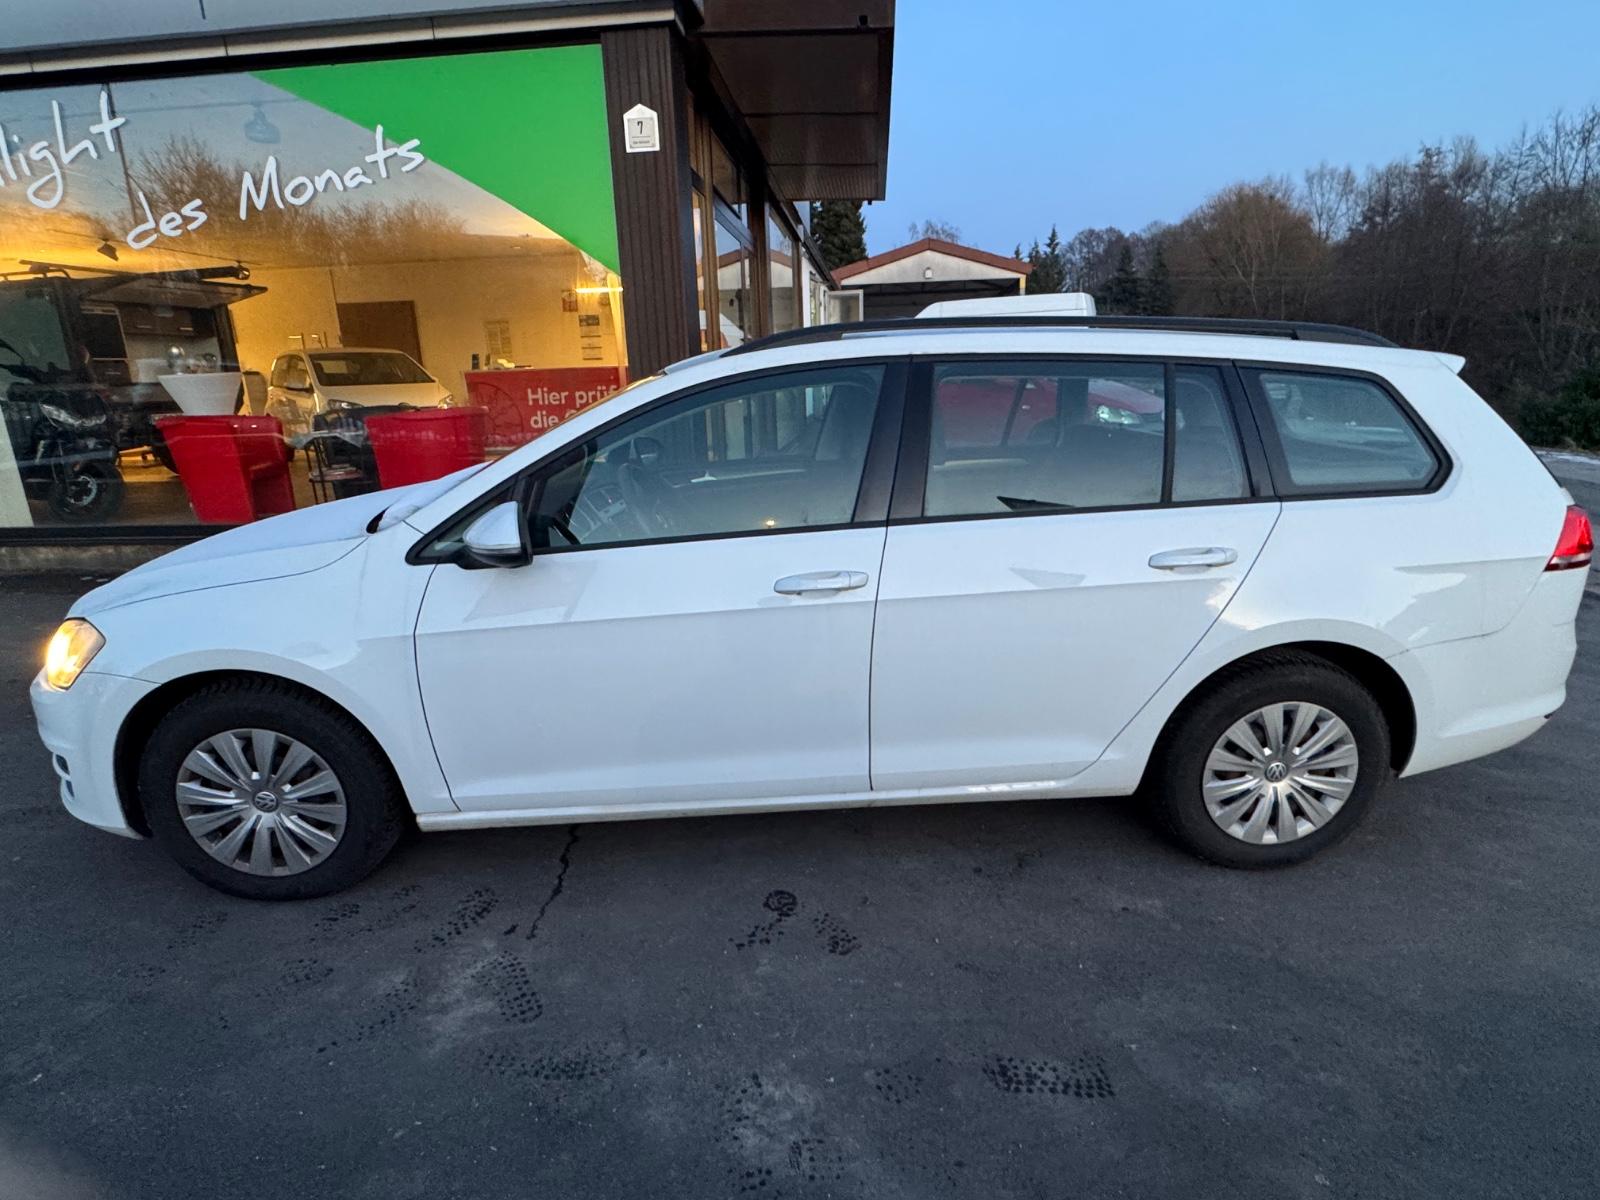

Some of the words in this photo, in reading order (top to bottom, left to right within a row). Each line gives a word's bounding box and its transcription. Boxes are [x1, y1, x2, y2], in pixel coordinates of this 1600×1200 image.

[636, 120, 644, 135] 7
[0, 90, 126, 209] light
[126, 191, 208, 250] des
[239, 124, 425, 221] Monats
[527, 386, 569, 406] Hier
[530, 410, 559, 429] die
